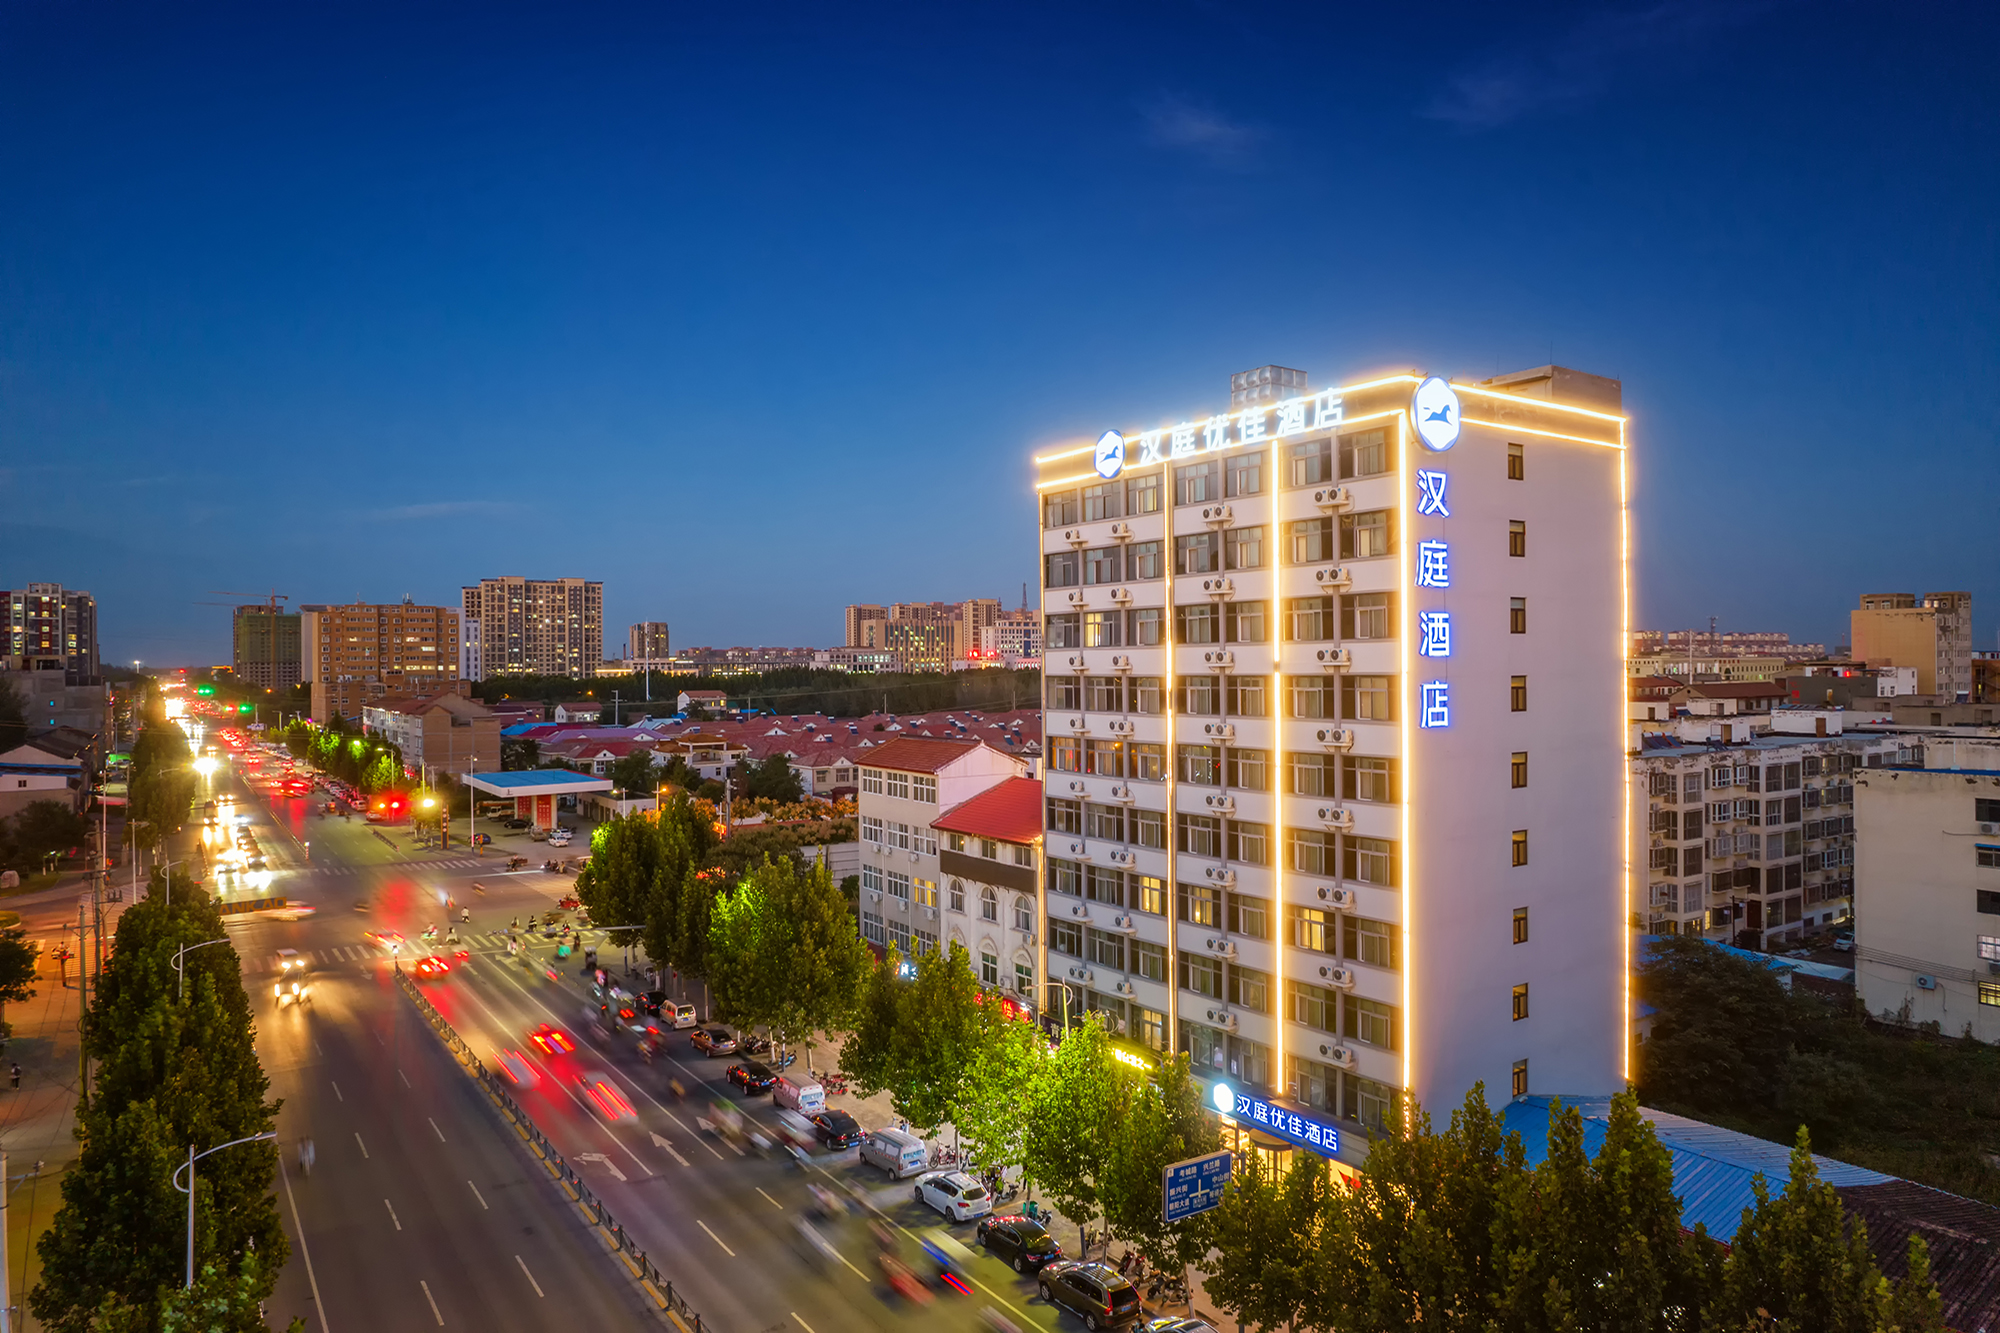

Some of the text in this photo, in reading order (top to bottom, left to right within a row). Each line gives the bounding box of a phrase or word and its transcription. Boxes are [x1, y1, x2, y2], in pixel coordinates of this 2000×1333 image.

[1140, 388, 1344, 463] 汉庭优佳酒店
[1415, 469, 1450, 729] 汉庭酒店
[1236, 1094, 1338, 1151] 汉庭优佳酒店
[1212, 1172, 1229, 1183] 中山街
